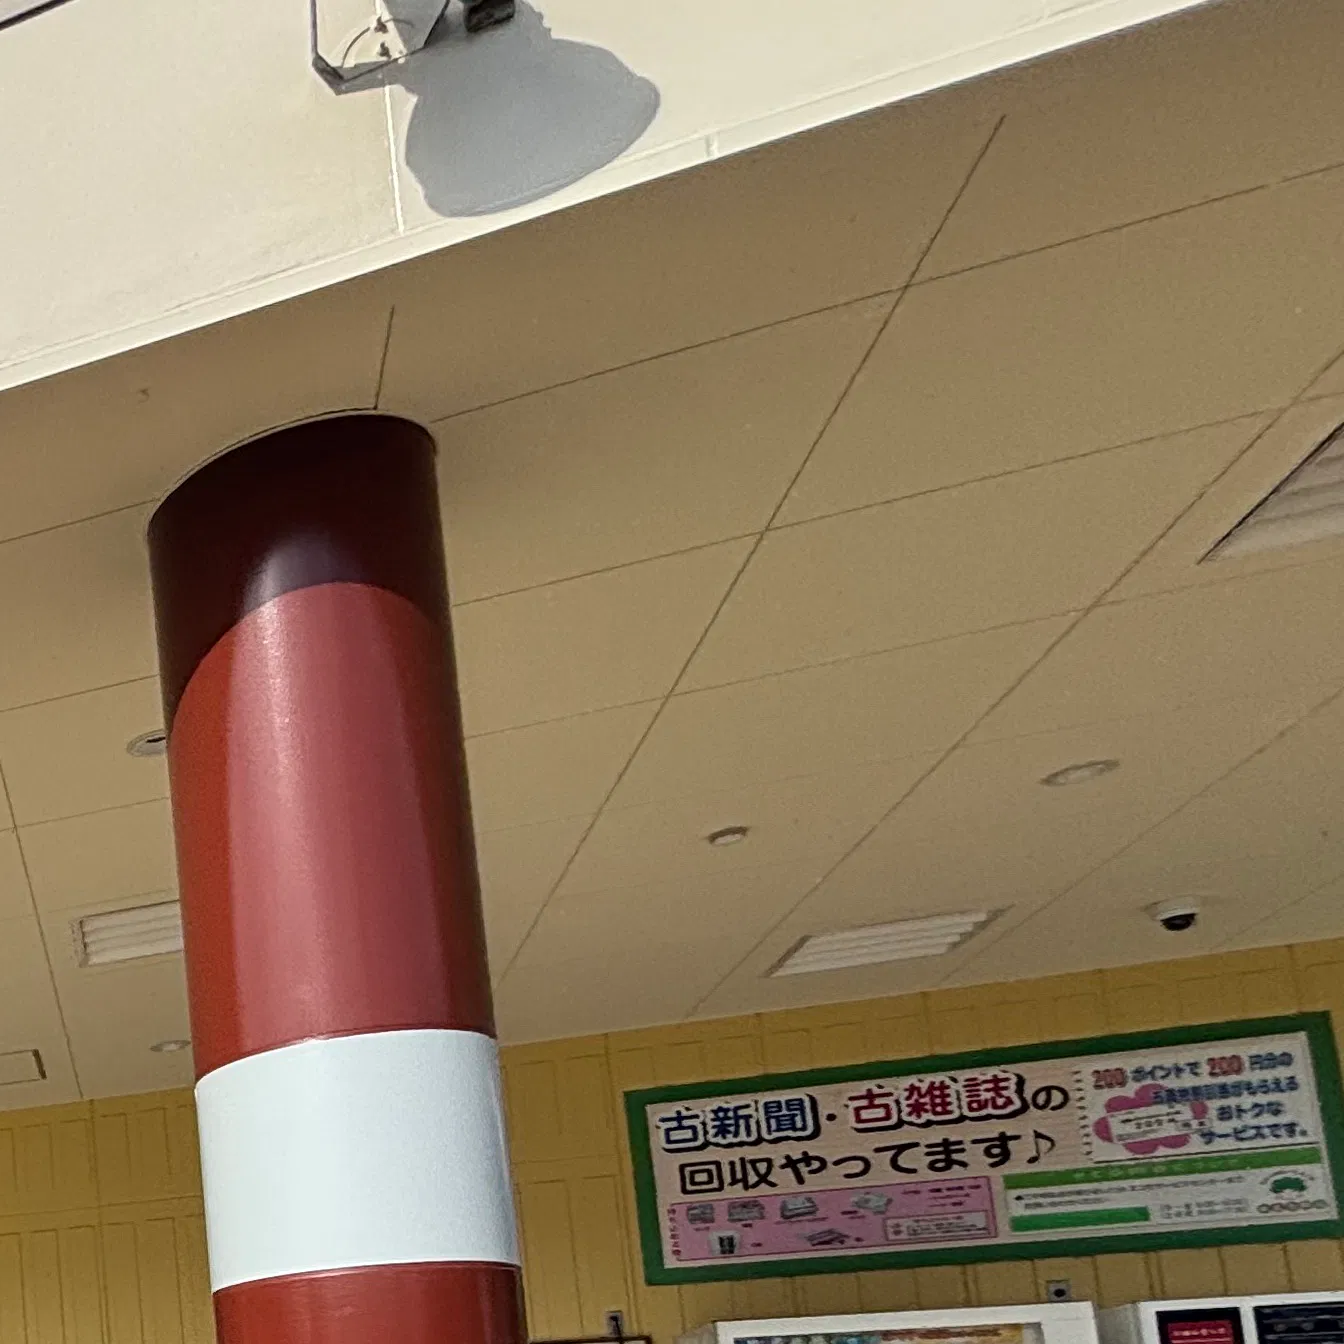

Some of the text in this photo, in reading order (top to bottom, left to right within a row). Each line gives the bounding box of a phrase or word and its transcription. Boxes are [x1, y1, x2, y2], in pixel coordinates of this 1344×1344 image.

[657, 1072, 1070, 1153] 古新聞・古雑誌の
